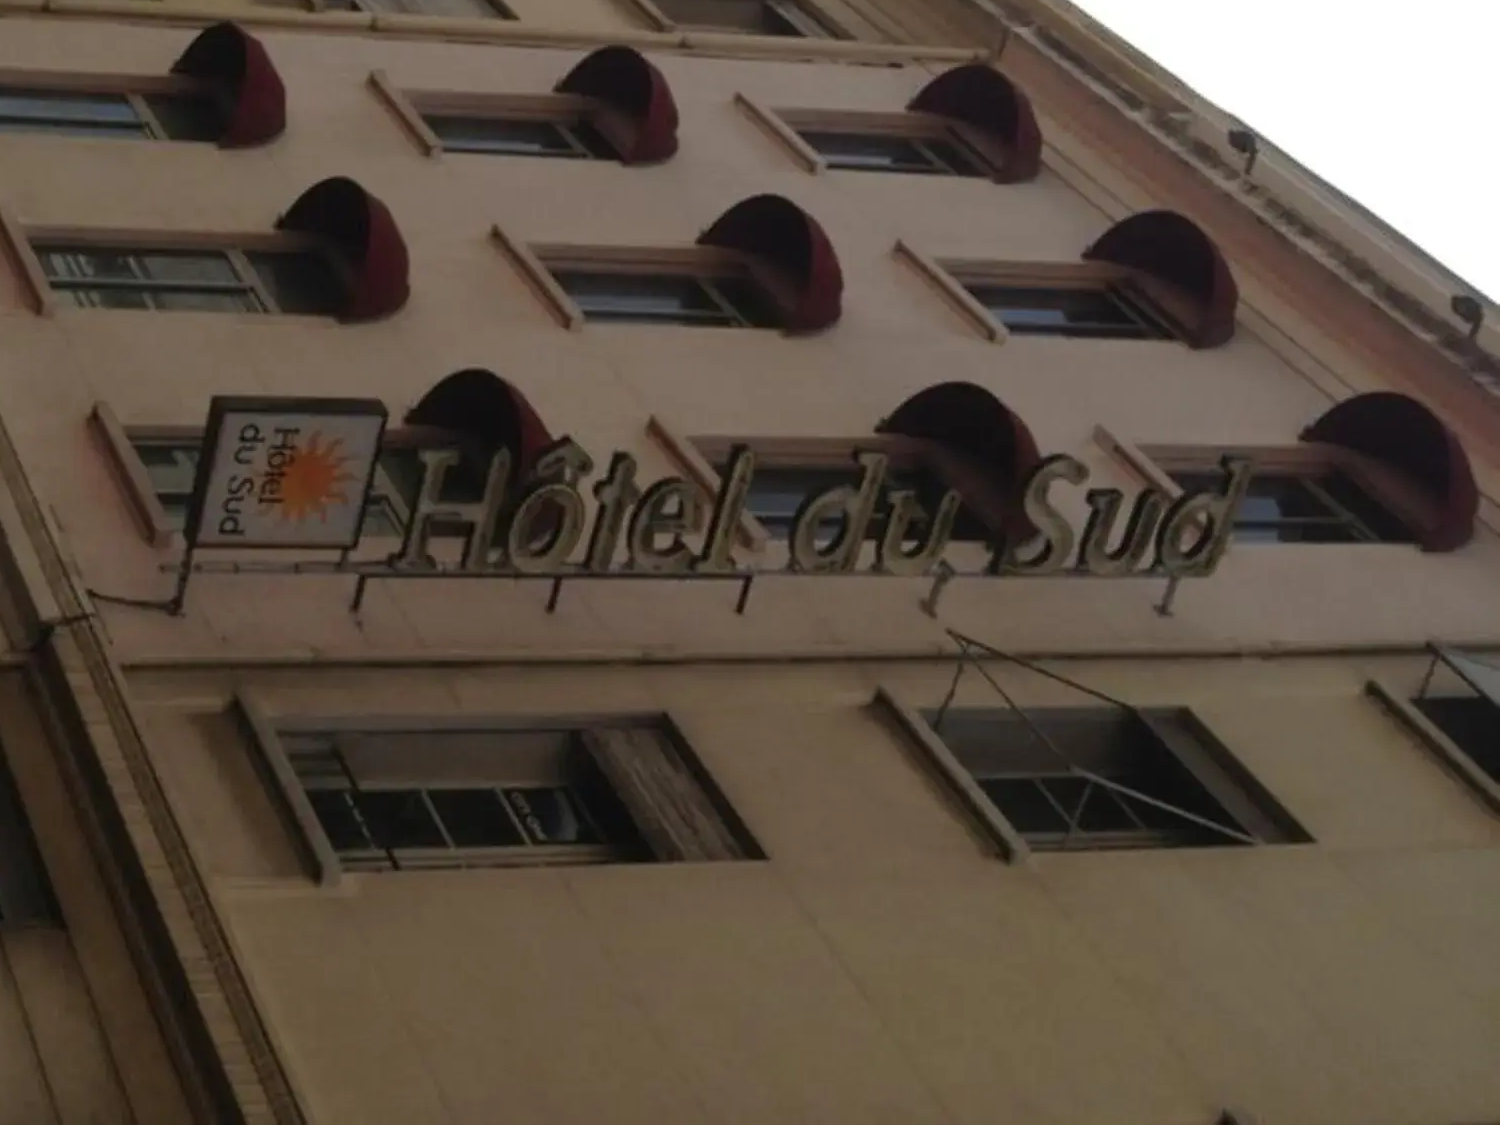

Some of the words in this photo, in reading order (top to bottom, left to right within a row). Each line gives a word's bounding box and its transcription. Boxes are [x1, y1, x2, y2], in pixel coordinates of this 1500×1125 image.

[234, 424, 265, 464] du
[258, 427, 300, 505] Hôtel
[219, 475, 255, 536] Sud
[388, 437, 754, 575] Hôtel
[790, 451, 962, 575] du
[984, 455, 1250, 576] Sud
